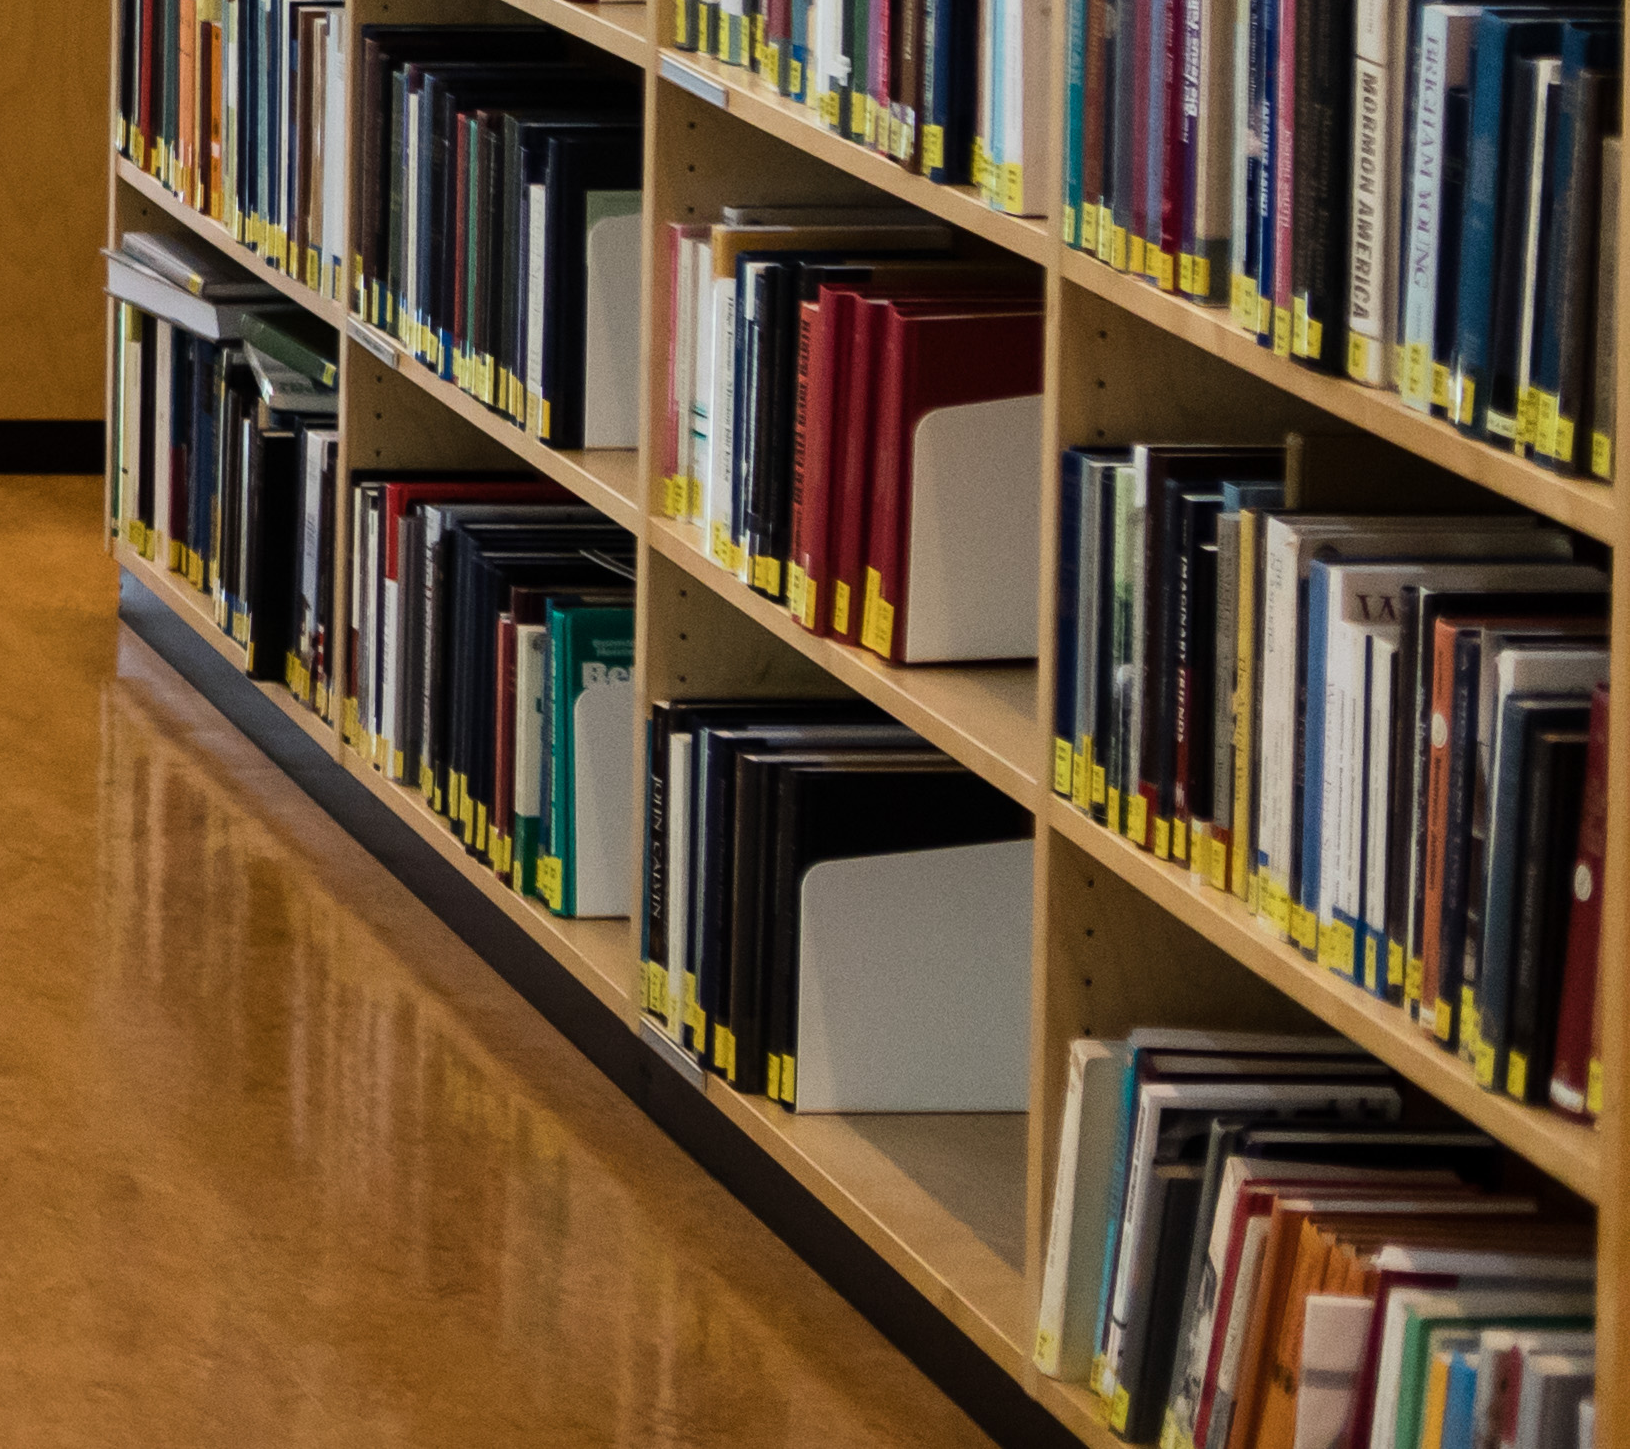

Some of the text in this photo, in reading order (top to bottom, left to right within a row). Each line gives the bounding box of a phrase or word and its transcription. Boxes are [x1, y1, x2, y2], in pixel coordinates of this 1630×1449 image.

[1352, 71, 1380, 319] MORMON AMERICA
[1413, 35, 1440, 287] BRIGHAM YOUNG
[1176, 556, 1189, 743] IMAGINARY FRIENDS
[651, 775, 664, 919] JOHN CALVIN
